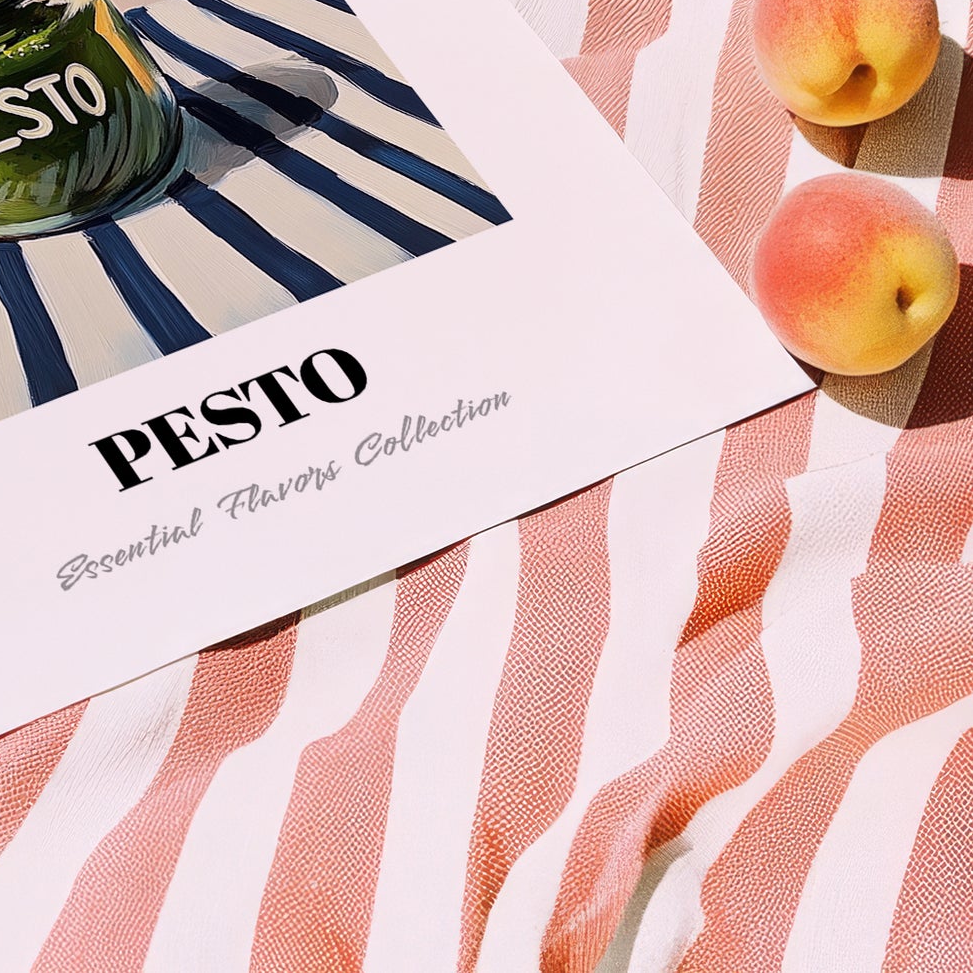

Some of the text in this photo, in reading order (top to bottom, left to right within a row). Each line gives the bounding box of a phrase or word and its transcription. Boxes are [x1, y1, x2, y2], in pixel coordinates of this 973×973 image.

[56, 390, 512, 592] Essential Flavors Collection
[87, 348, 368, 493] PESTO
